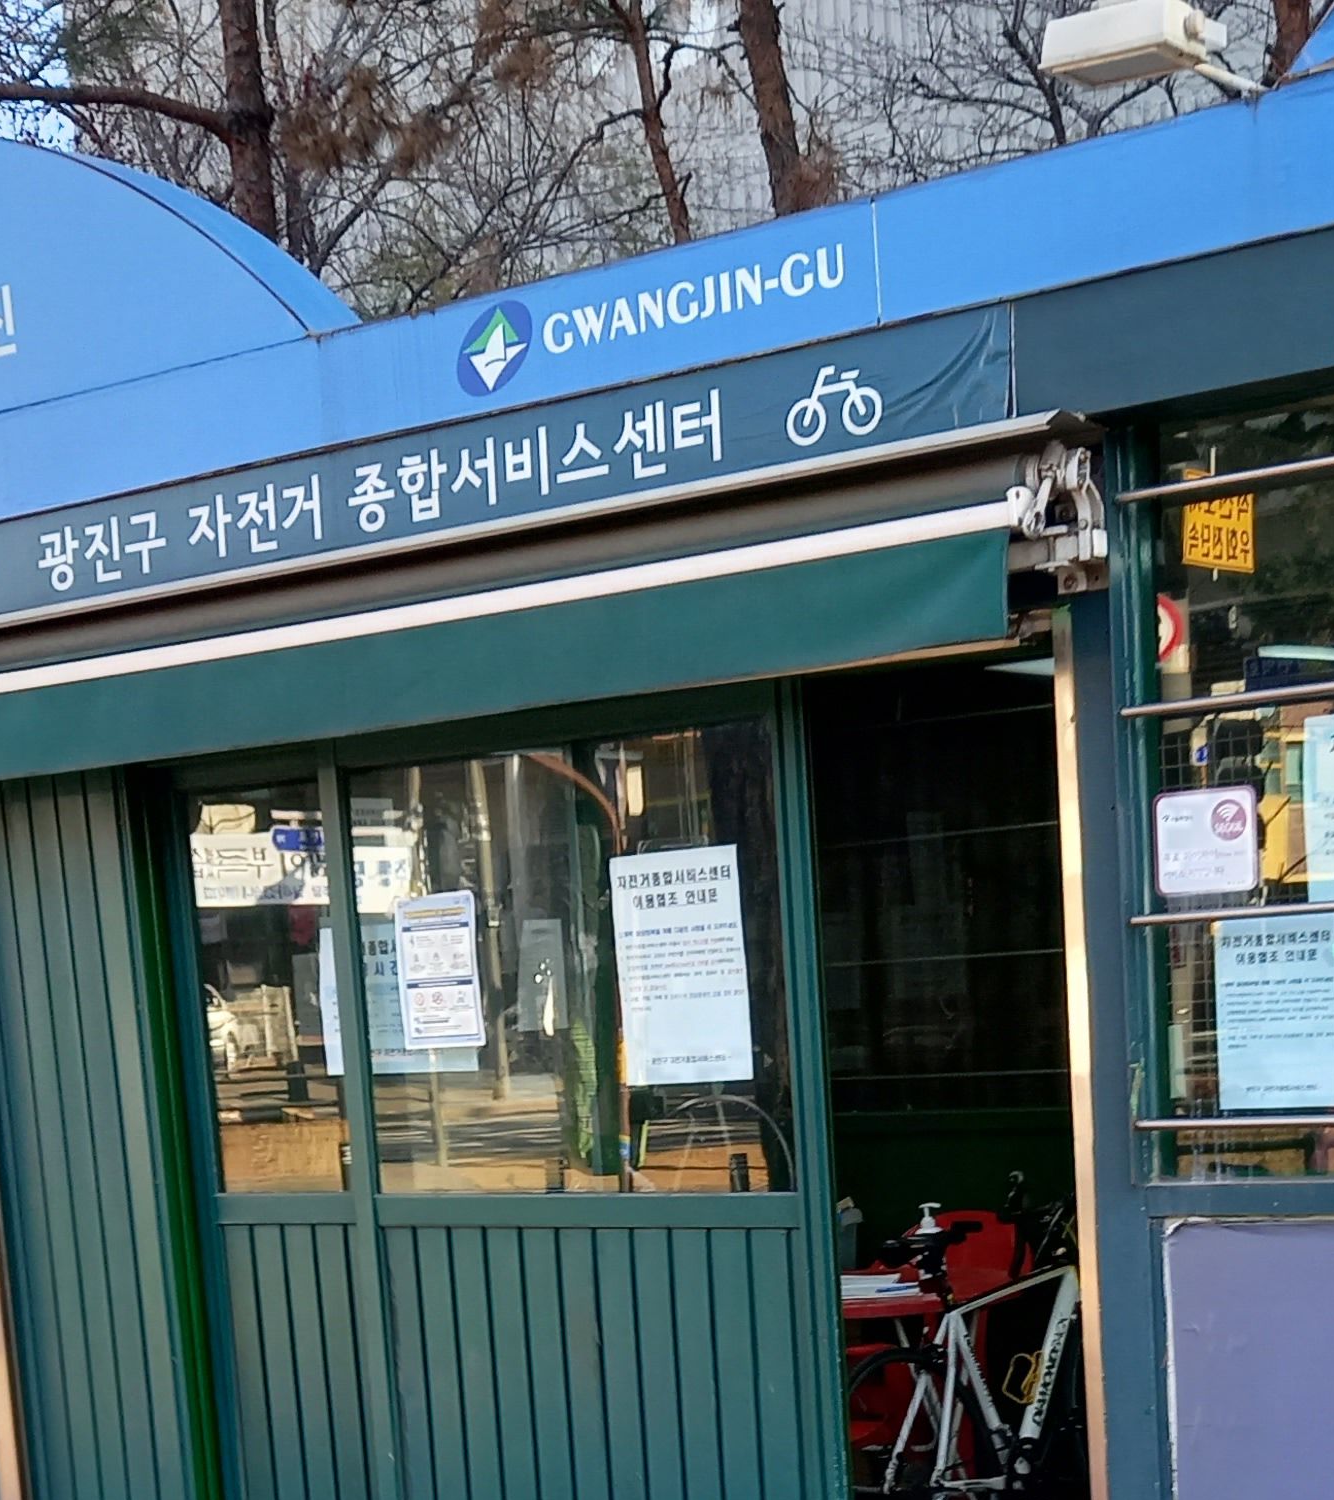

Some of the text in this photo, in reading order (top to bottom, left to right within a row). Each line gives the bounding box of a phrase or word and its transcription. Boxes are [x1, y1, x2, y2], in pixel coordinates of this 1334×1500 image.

[543, 243, 845, 355] GWANGJIN-GU
[37, 388, 724, 592] 광진구 자전거 종합서비스센터
[616, 864, 732, 890] 자전거종합서비스센터
